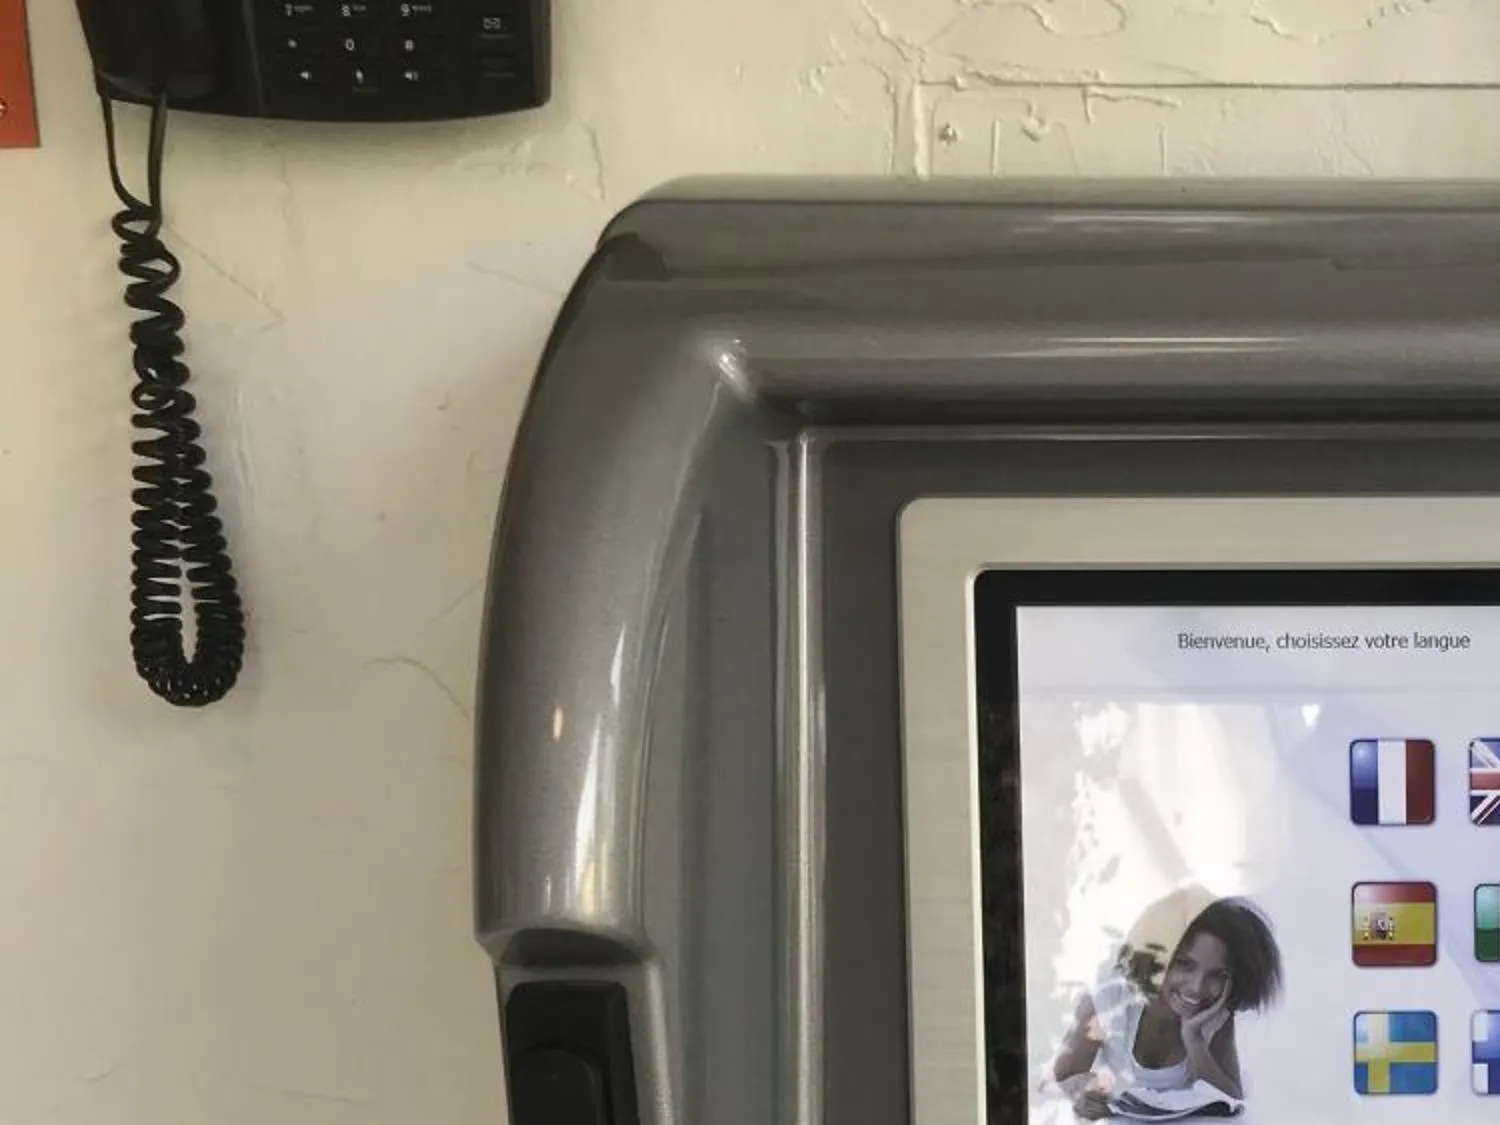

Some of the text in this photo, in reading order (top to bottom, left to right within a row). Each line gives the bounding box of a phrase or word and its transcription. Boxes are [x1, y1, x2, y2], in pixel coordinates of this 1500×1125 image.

[342, 5, 351, 16] 8
[401, 4, 410, 16] 9
[346, 39, 355, 51] 0
[1178, 631, 1471, 652] Bienvenue, choisissez votre langue
